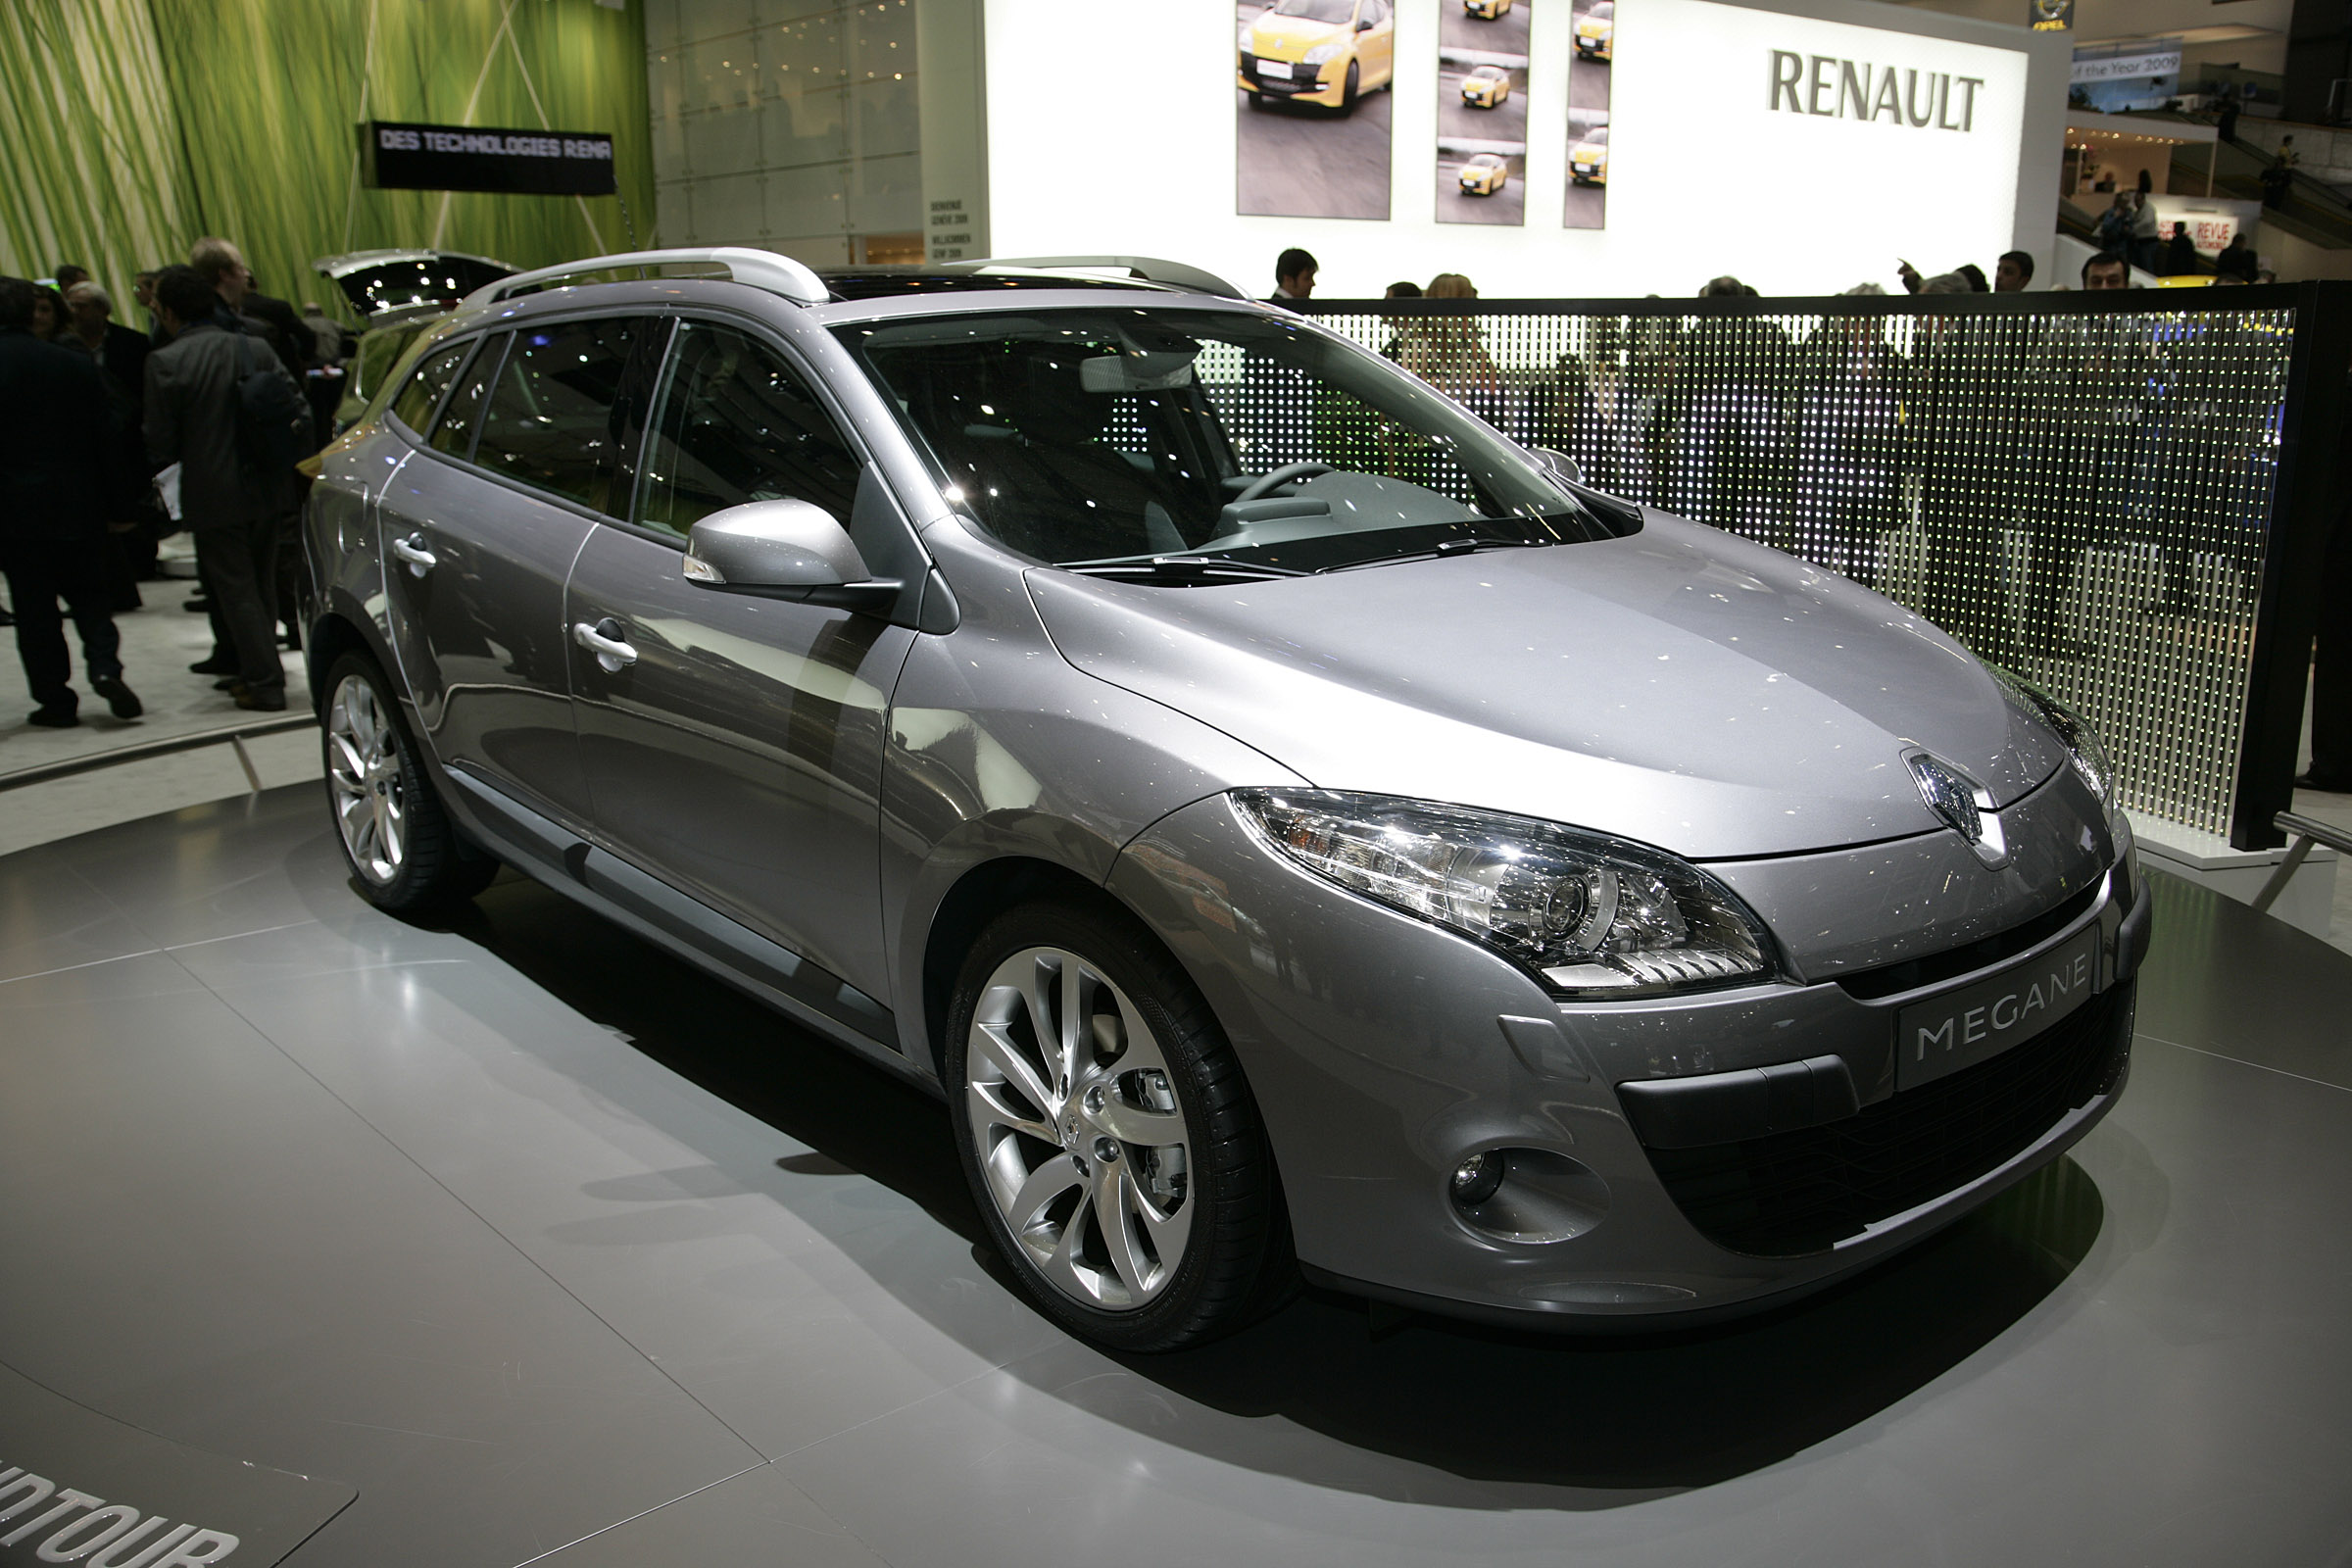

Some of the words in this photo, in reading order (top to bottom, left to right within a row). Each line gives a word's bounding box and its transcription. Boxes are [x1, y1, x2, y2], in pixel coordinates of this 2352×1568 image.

[2111, 60, 2140, 74] Year
[2143, 56, 2179, 73] 2009
[1767, 49, 1984, 132] RENAULT
[379, 129, 420, 151] DES
[422, 131, 562, 158] TECHNOLOGIES
[2196, 221, 2230, 241] REVUE
[1917, 953, 2086, 1061] MEGANE
